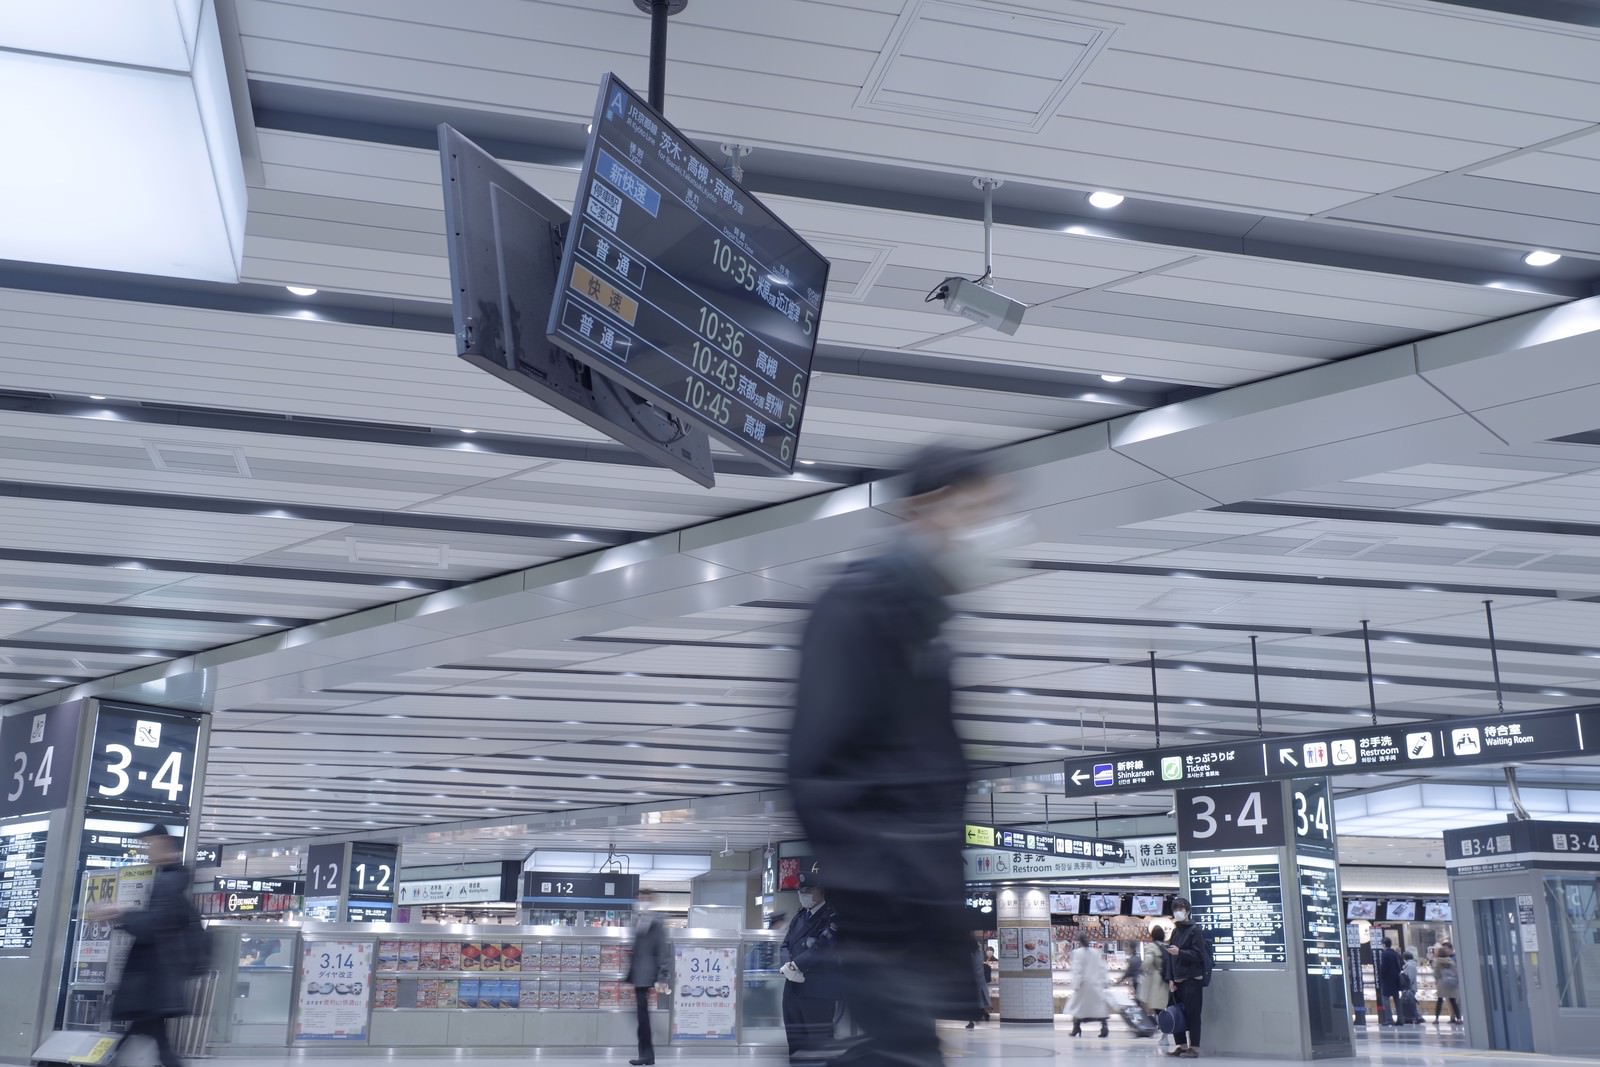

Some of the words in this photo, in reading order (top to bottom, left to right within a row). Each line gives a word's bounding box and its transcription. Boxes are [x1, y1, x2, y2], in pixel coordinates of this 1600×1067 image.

[611, 92, 624, 115] A
[609, 162, 648, 206] 新快速
[596, 239, 631, 268] 普通
[712, 238, 757, 292] 10:35
[587, 276, 624, 315] 快速
[580, 313, 616, 351] 普通
[699, 306, 745, 358] 10:36
[803, 309, 815, 336] 5
[692, 341, 738, 392] 10:43
[792, 373, 803, 399] 6
[685, 376, 733, 426] 10:45
[786, 404, 798, 430] 5
[780, 436, 792, 462] 6
[1359, 735, 1393, 749] お手洗
[1485, 723, 1522, 738] 待合室
[1485, 737, 1513, 747] Waiting
[1514, 735, 1535, 745] Room
[1186, 750, 1236, 765] きっぷうりば
[1360, 747, 1400, 758] Restroom
[8, 745, 54, 802] 3·4
[98, 743, 184, 802] 3·4
[1117, 760, 1144, 771] 新幹線
[1118, 770, 1155, 779] Shinkansen
[1186, 764, 1211, 774] Tickets
[1191, 791, 1269, 840] 3·4
[1294, 791, 1330, 840] 3·4
[1140, 842, 1178, 856] 待合室
[1473, 837, 1496, 856] 3·4
[1569, 834, 1600, 853] 3·4
[1012, 864, 1053, 873] Restroom
[1140, 856, 1178, 869] Waiting
[314, 862, 338, 891] 1·2
[356, 863, 392, 893] 1·2
[555, 882, 575, 895] 1·2
[320, 952, 355, 970] 3.14
[690, 957, 722, 973] 3.14
[318, 971, 354, 979] ダイヤ改正
[690, 974, 721, 982] ダイヤ改正
